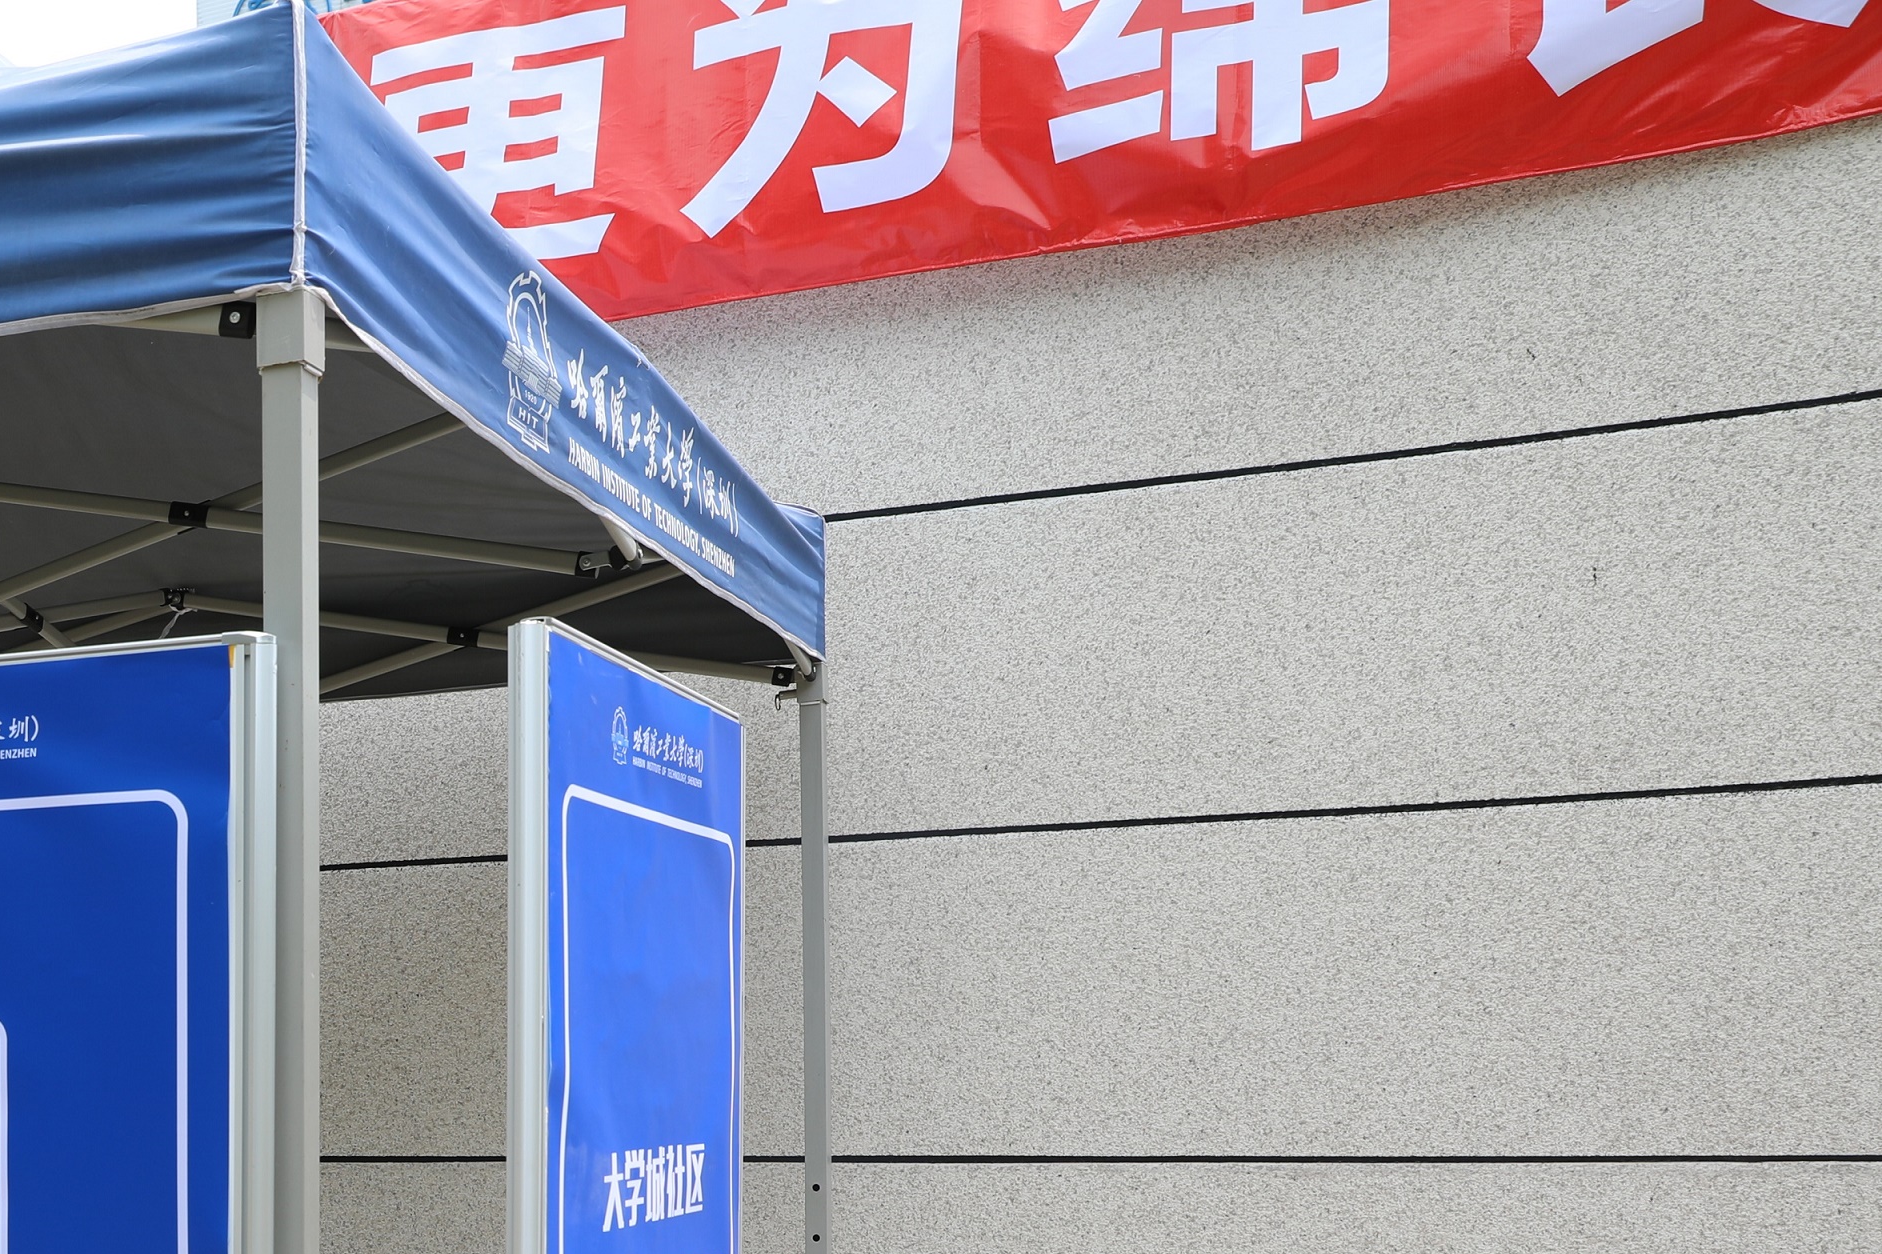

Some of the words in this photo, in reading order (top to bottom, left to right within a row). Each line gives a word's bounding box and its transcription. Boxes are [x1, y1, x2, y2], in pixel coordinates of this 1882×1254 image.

[518, 406, 539, 429] HIT
[568, 436, 601, 485] HARBIN
[602, 462, 641, 514] INSTITUTE
[641, 493, 654, 522] OF
[653, 503, 701, 558] TECHNOLOGY,
[701, 536, 736, 578] SHENZHEN
[602, 1142, 706, 1233] 大学城社区
